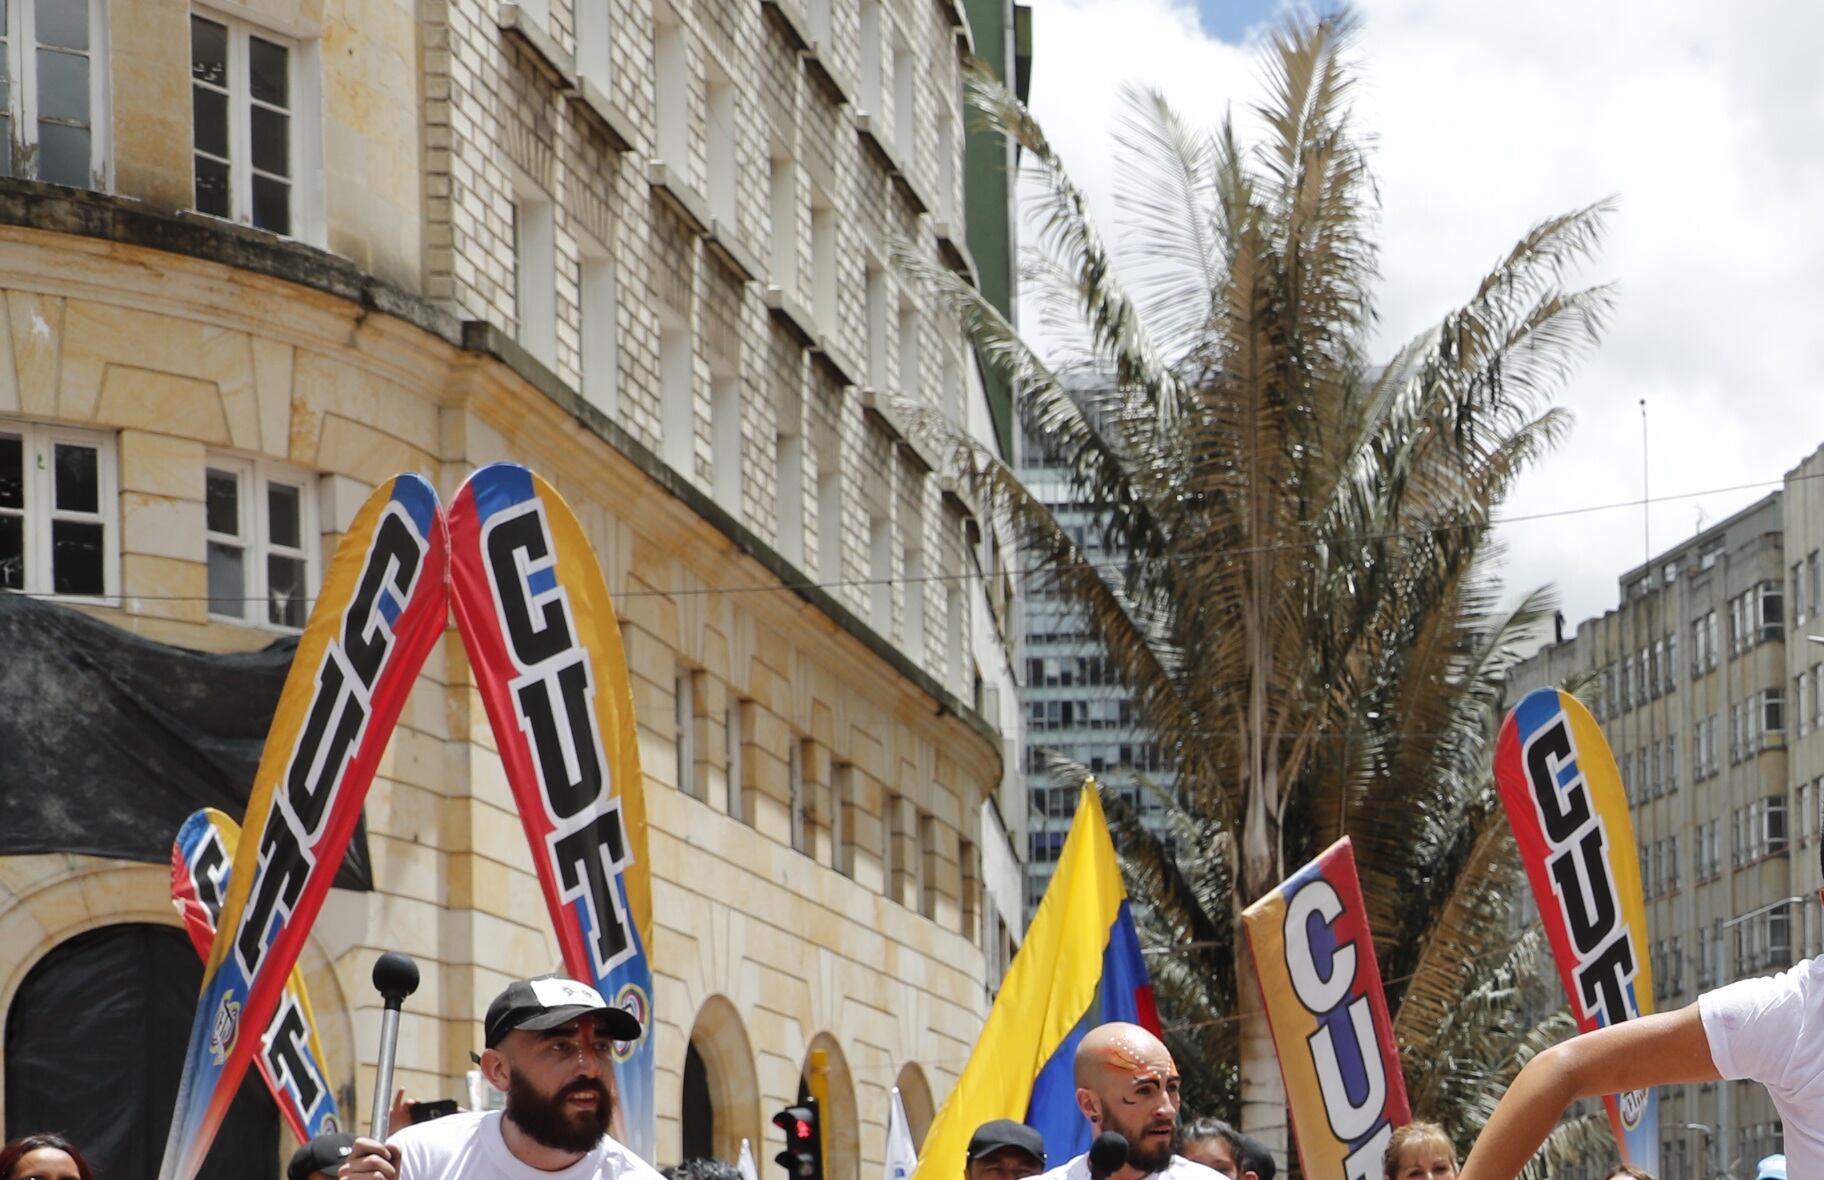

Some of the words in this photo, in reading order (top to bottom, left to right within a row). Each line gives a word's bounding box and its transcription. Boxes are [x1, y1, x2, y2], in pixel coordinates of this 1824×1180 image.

[238, 503, 428, 985] CUT
[483, 503, 632, 973] CUT
[1523, 713, 1639, 1026] CUT
